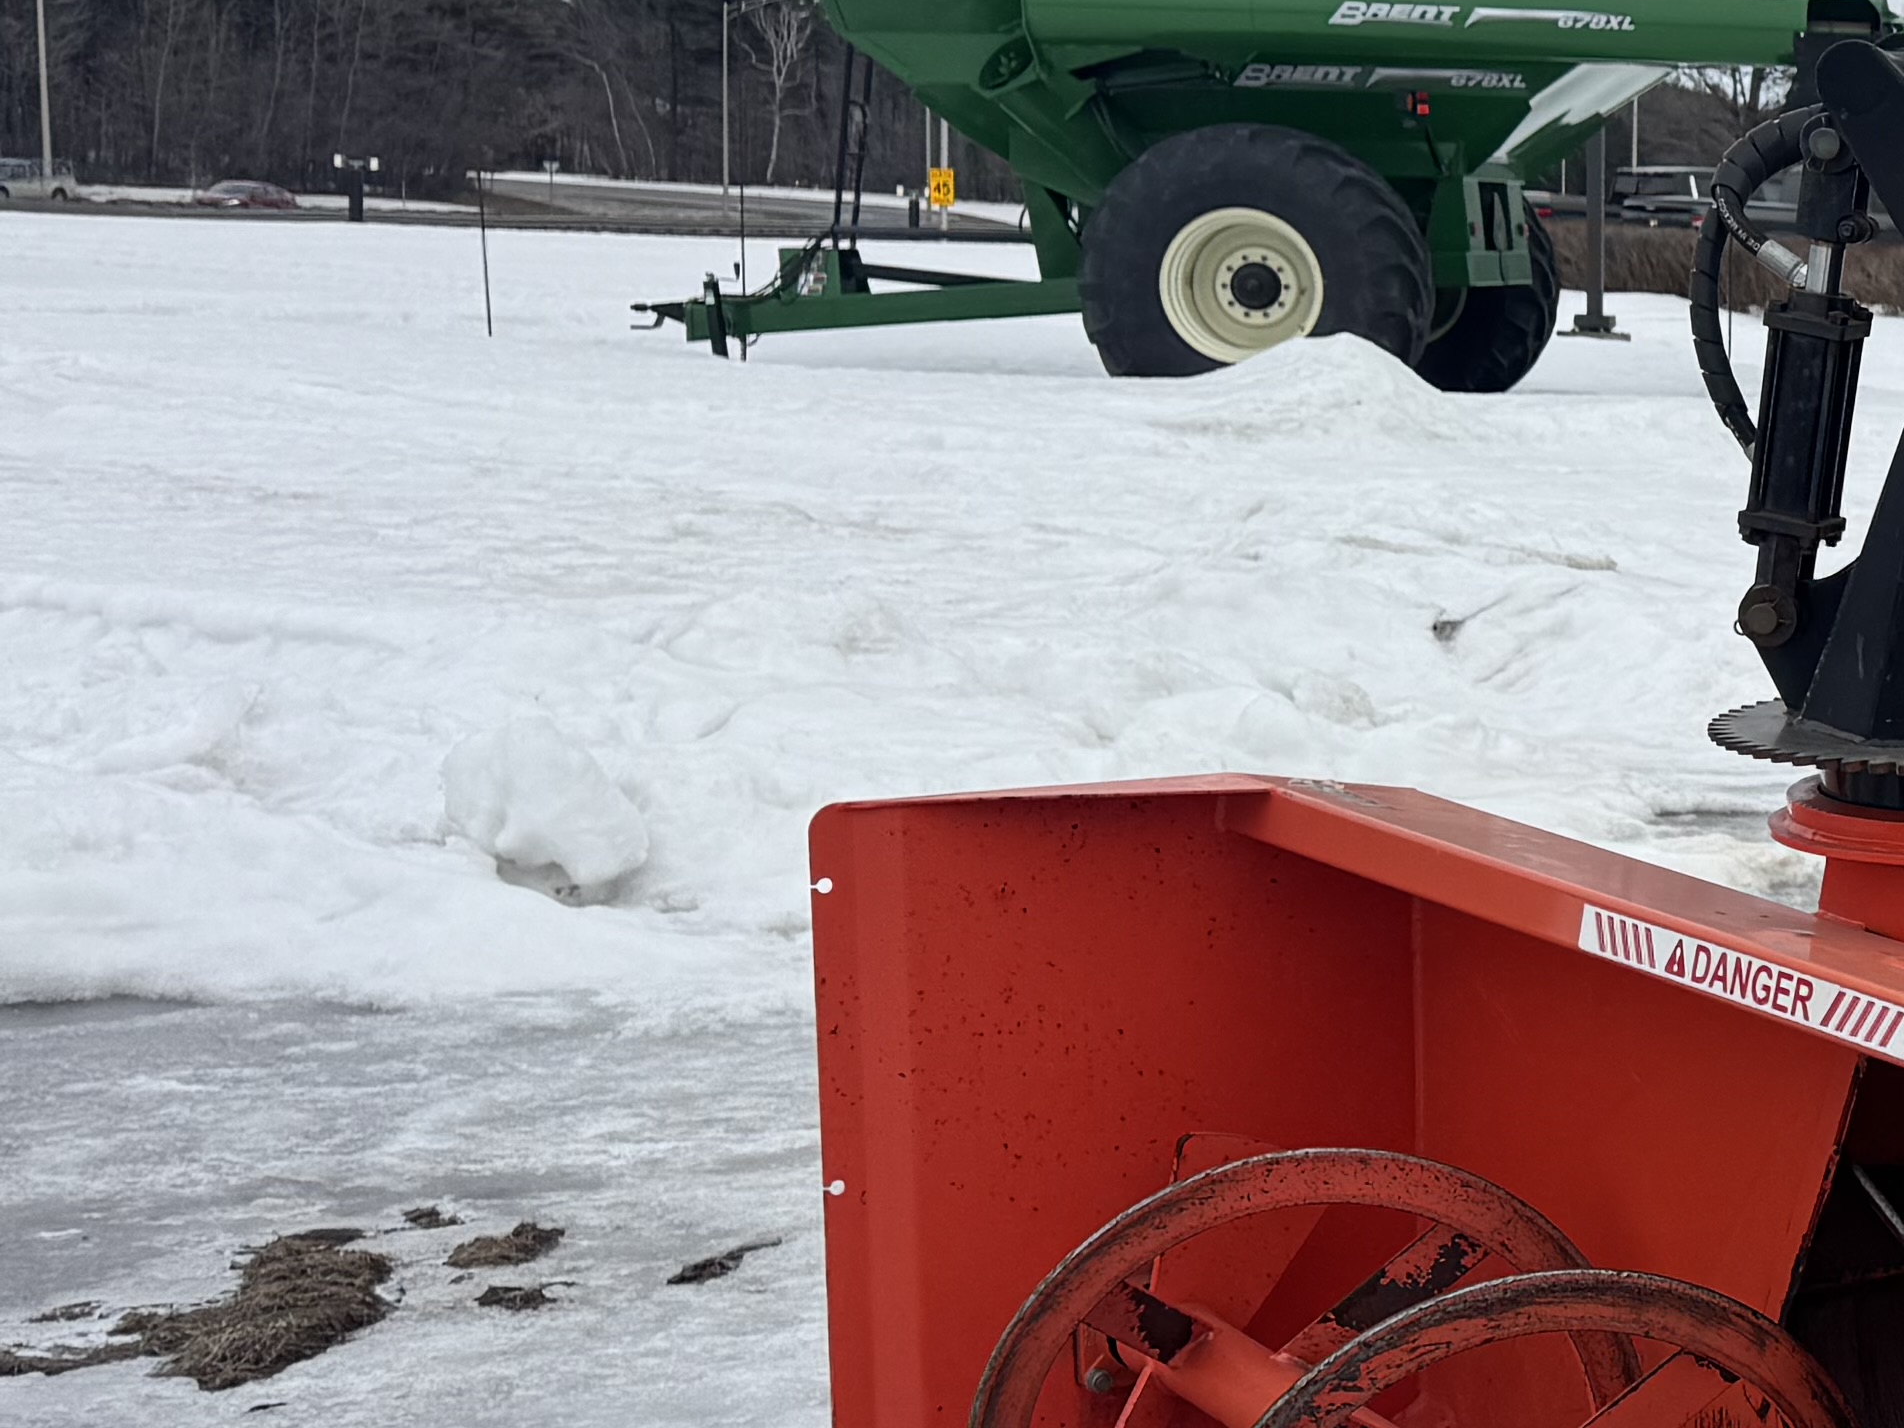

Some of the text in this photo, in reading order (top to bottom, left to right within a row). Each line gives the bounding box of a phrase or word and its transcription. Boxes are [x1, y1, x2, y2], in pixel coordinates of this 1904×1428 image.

[1328, 1, 1460, 26] BRENT
[1233, 63, 1362, 87] BRENT
[1691, 943, 1815, 1022] DANGER
